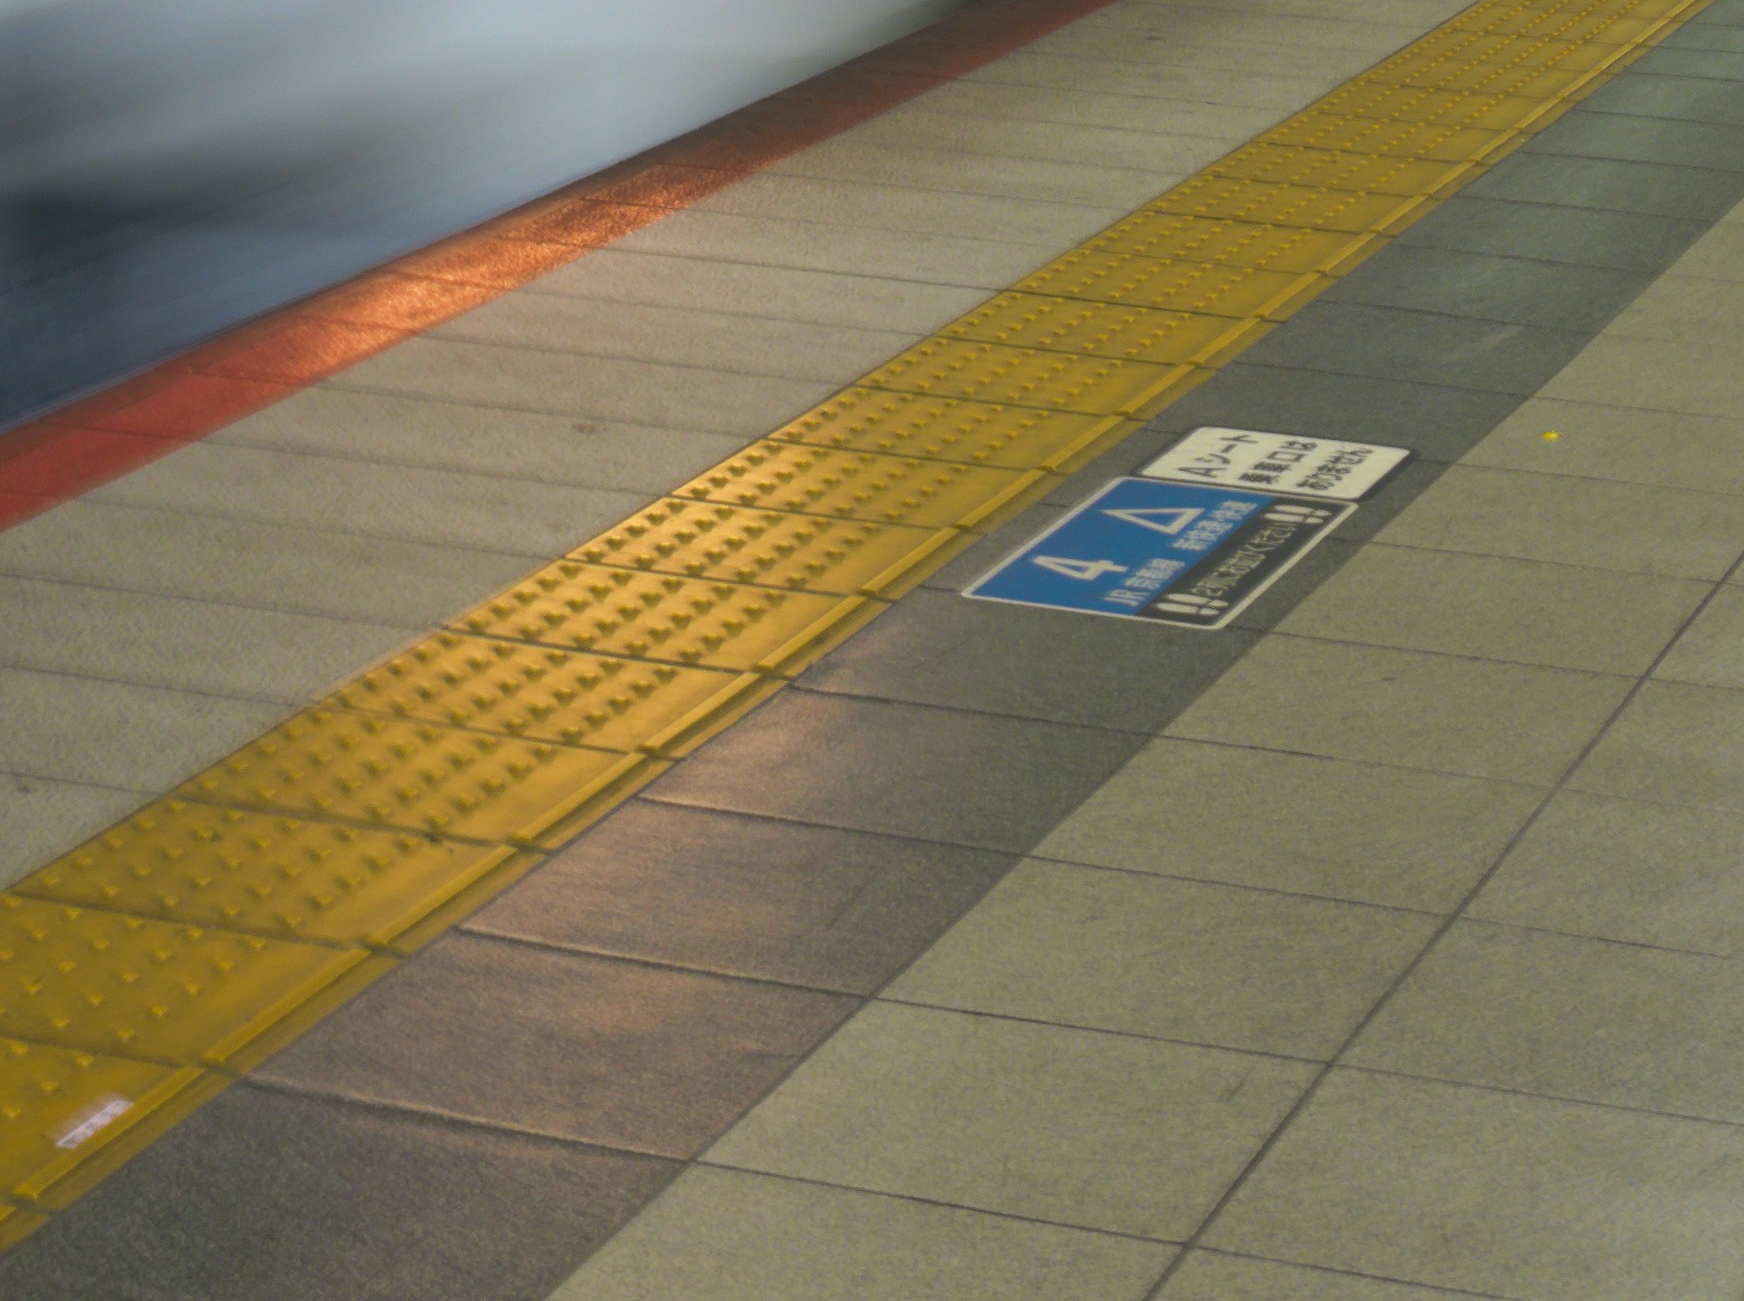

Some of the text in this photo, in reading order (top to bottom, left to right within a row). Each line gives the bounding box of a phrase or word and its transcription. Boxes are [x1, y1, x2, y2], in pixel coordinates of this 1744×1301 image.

[1176, 434, 1259, 479] Aシート
[1031, 554, 1129, 581] 4
